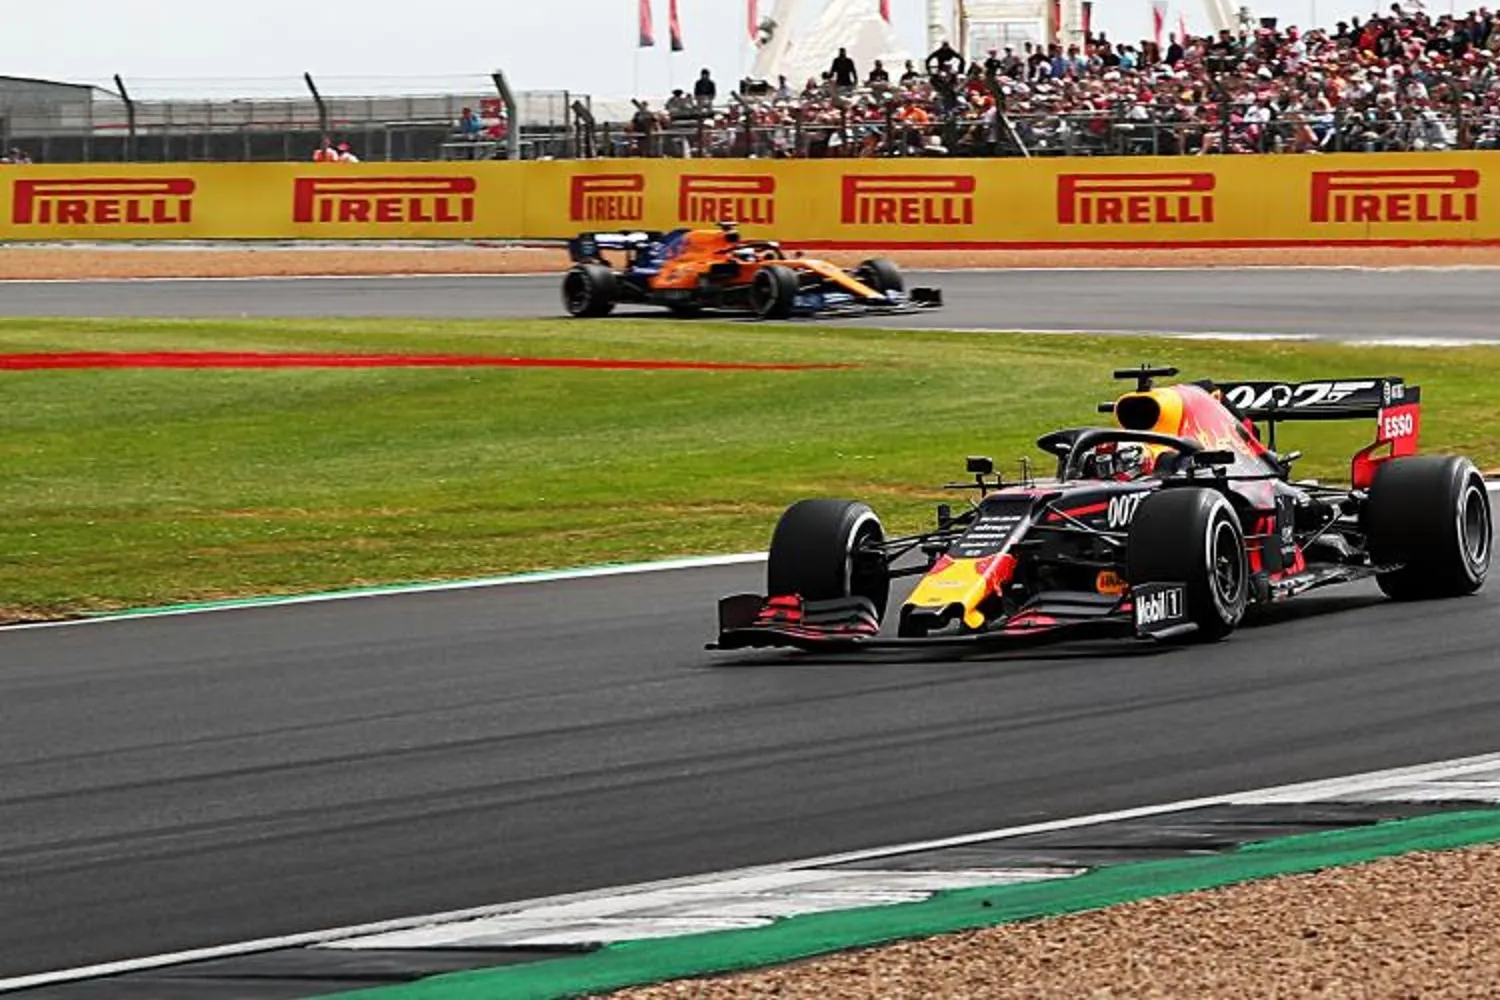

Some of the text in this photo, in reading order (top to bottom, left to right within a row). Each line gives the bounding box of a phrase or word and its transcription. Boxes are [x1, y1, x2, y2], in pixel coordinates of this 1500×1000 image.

[12, 178, 195, 224] PIRELLI
[293, 177, 477, 223] PIRELLI
[570, 174, 644, 220] PIRELLI
[678, 174, 776, 224] PIRELLI
[840, 174, 977, 225] PIRELLI
[1057, 172, 1216, 224] PIRELLI
[1310, 168, 1480, 223] PIRELLI
[1384, 413, 1413, 438] ESSO
[1108, 491, 1151, 529] 007
[1136, 591, 1165, 625] Mobil
